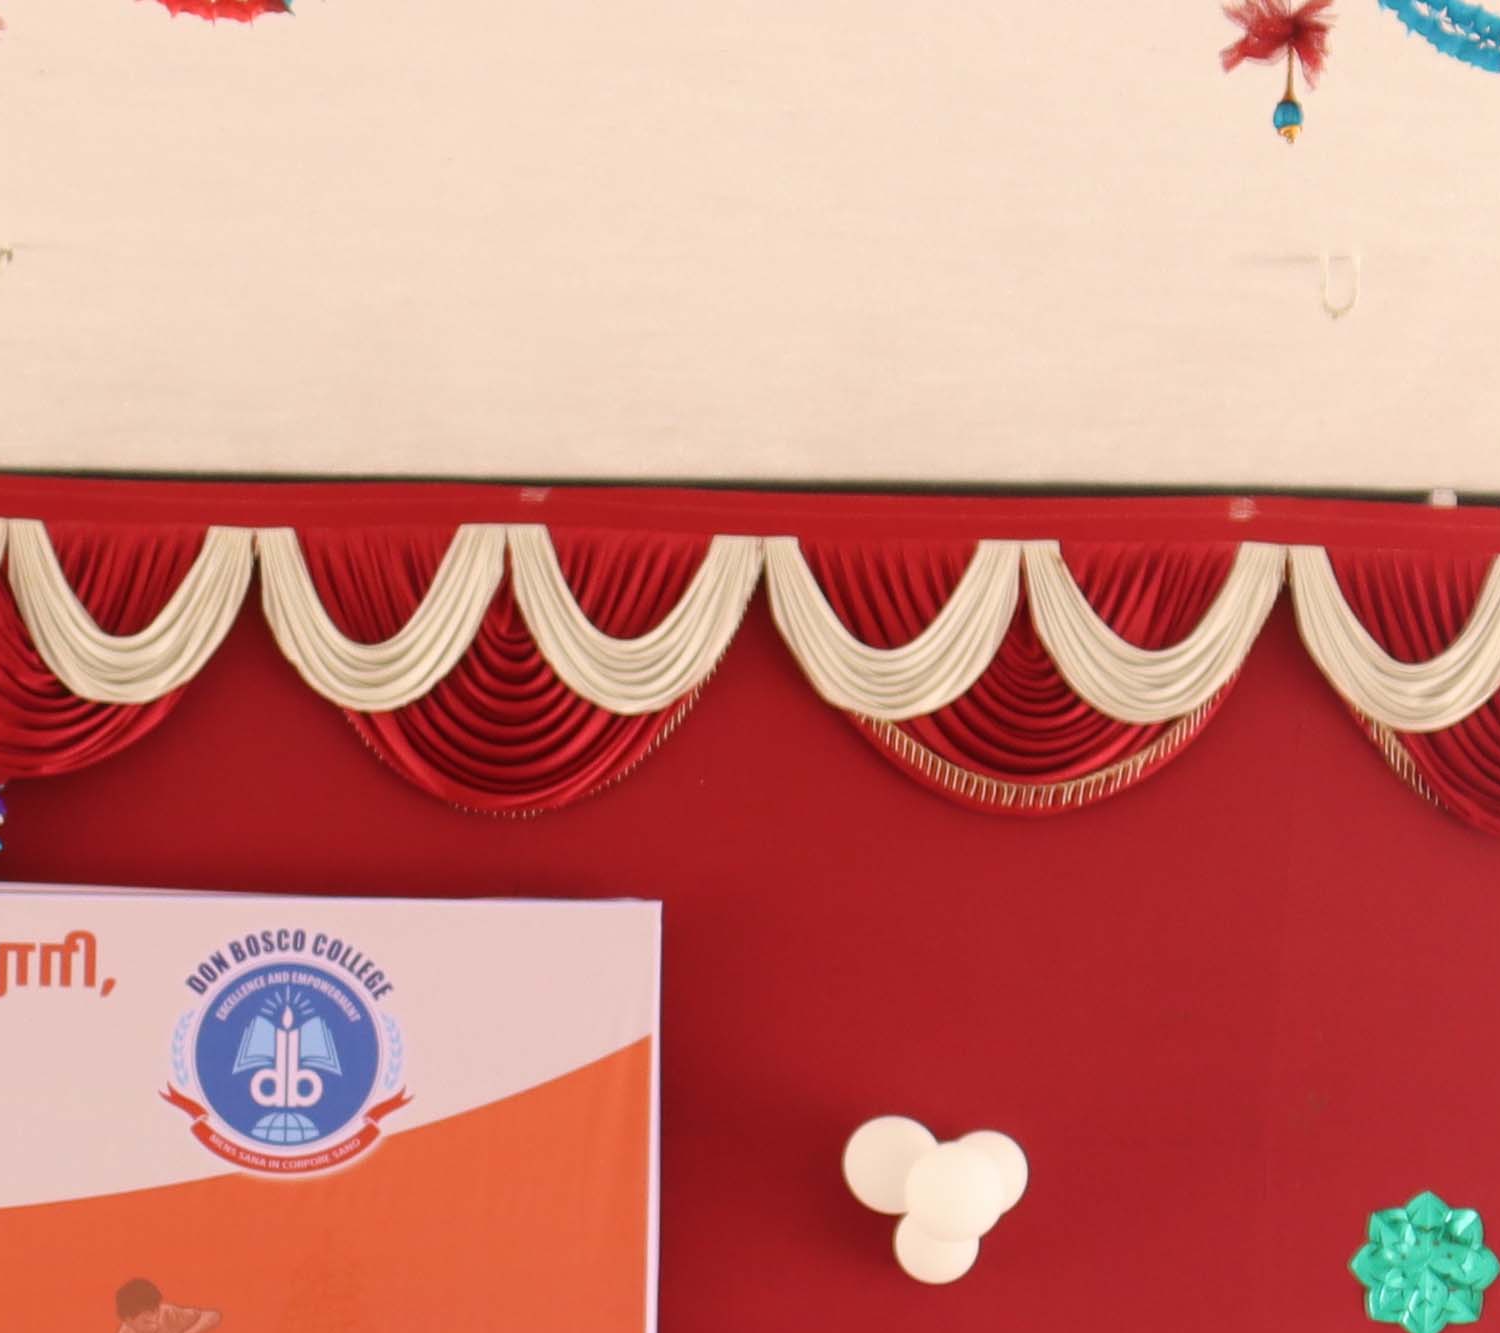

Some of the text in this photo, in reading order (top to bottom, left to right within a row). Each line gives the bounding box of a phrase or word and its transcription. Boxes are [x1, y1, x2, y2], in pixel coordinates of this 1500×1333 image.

[185, 929, 394, 1000] DON BOSCO COLLEGE
